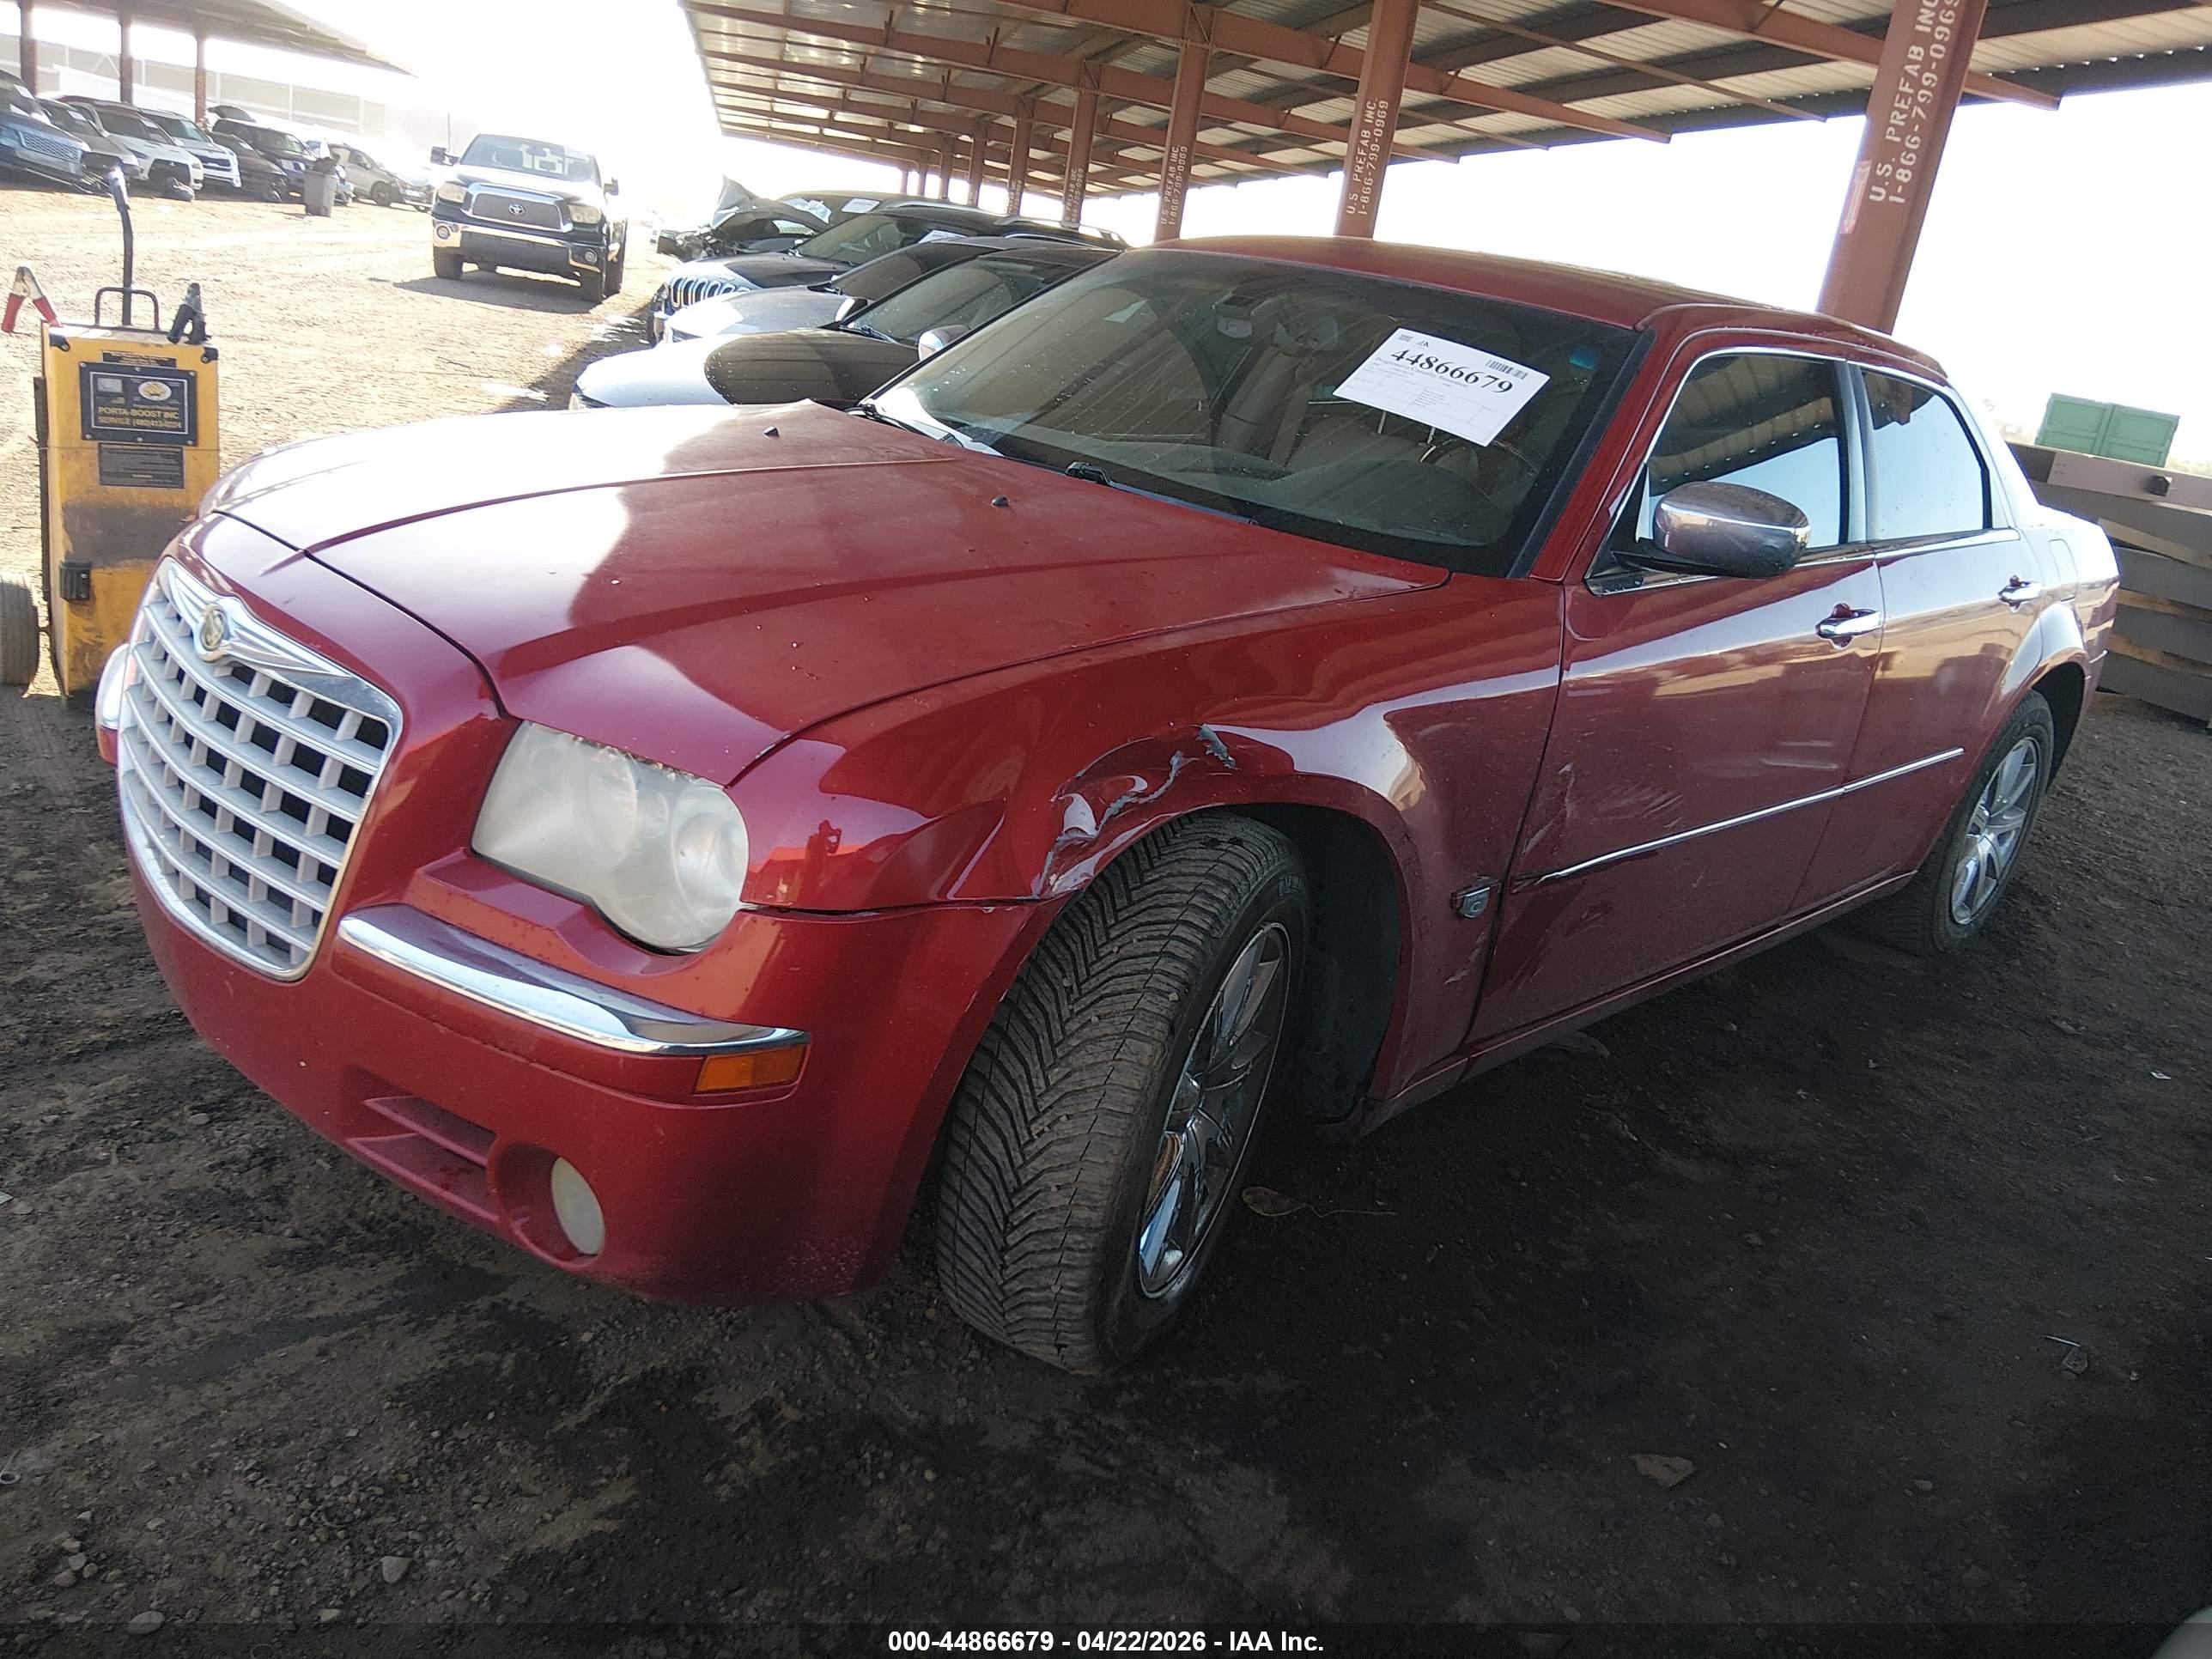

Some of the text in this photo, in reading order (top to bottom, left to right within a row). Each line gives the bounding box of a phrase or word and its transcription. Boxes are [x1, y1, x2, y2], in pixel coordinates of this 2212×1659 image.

[1352, 130, 1371, 182] PREFAB
[1364, 98, 1378, 124] INC.
[1358, 100, 1389, 215] 1-866-799-0969
[1869, 157, 1896, 202] U.S.
[1885, 45, 1924, 143] PREFAB
[1164, 166, 1176, 202] PREFAB
[1391, 349, 1513, 393] 44866679
